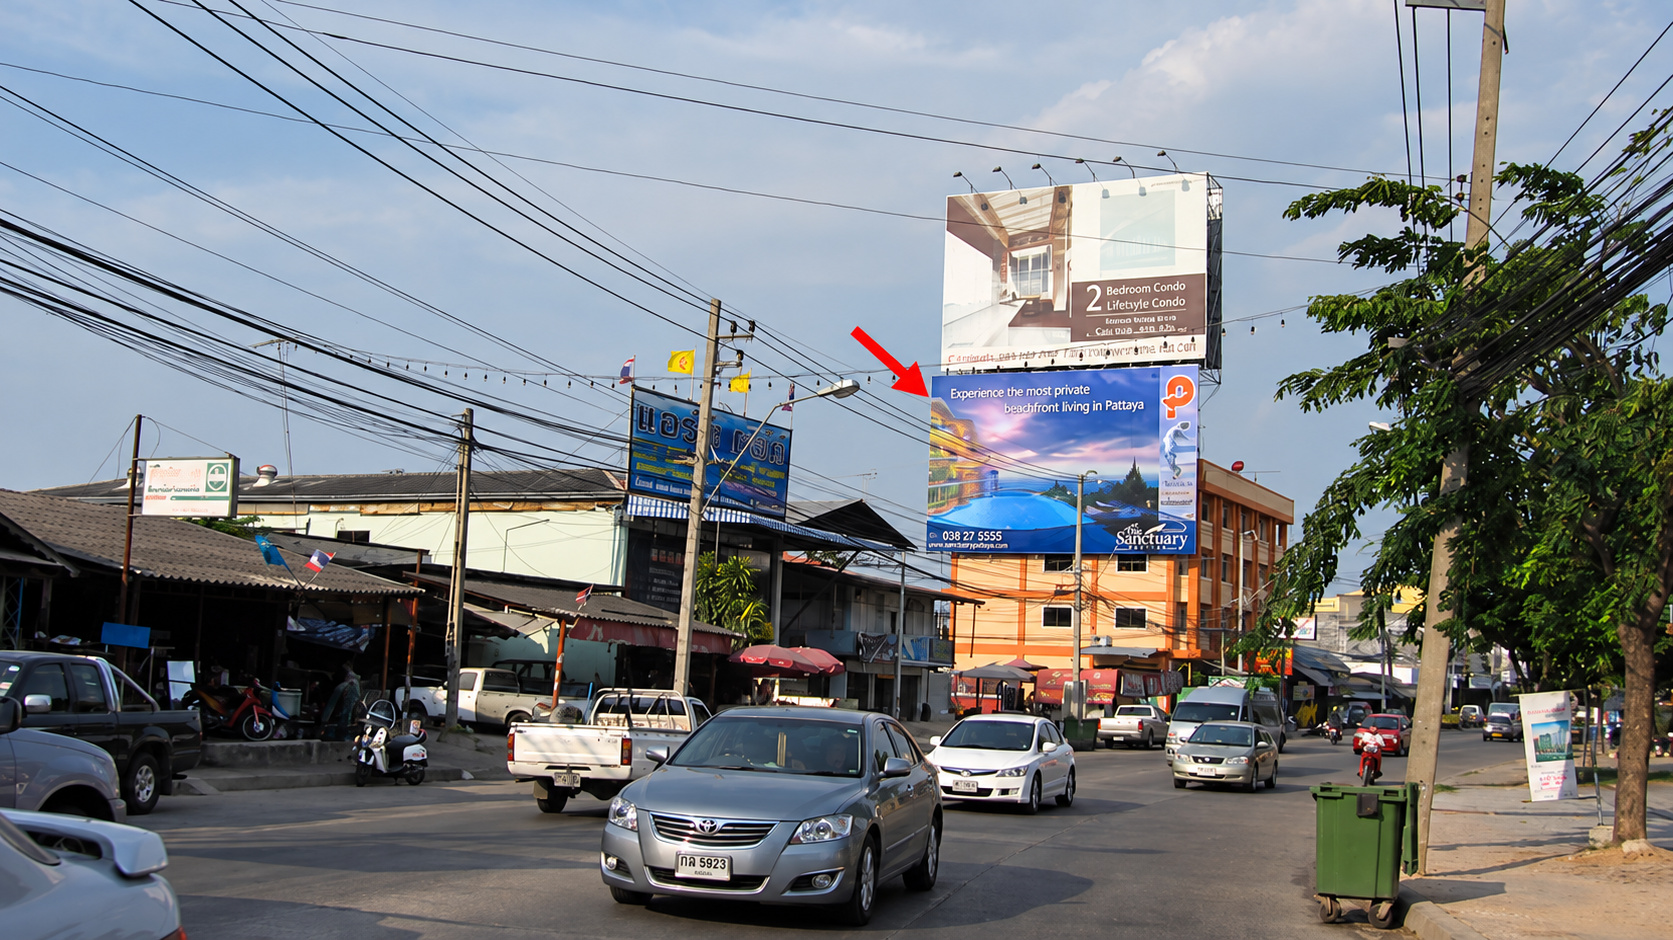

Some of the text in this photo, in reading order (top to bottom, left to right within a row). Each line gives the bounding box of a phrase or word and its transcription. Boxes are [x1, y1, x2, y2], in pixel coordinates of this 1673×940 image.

[1106, 281, 1186, 296] Bedroom Condo
[1086, 284, 1102, 312] 2
[1151, 296, 1186, 308] Condo
[950, 384, 1091, 401] Experience the most private
[1004, 400, 1145, 415] beachfront living in Pattaya
[942, 530, 1003, 541] 038 27 5555
[1115, 530, 1188, 551] Sanctuary
[699, 857, 726, 870] 5923
